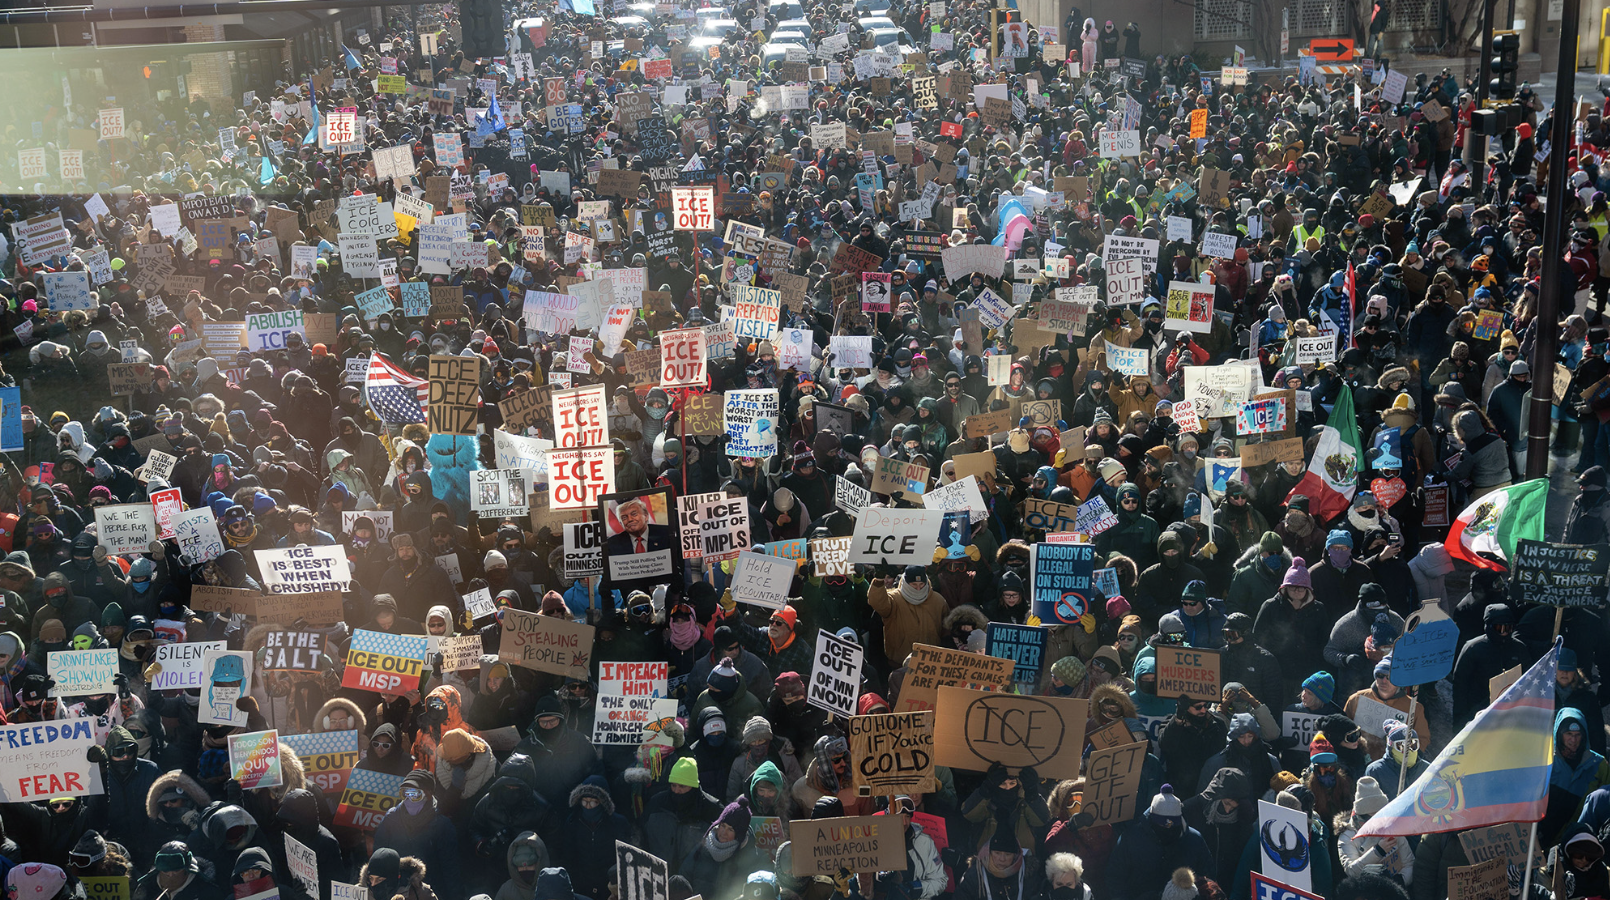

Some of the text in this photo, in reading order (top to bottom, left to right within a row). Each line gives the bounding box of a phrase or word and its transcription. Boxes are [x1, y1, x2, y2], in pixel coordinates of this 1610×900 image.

[915, 78, 936, 90] ICE
[952, 72, 968, 84] ICE
[433, 90, 450, 100] ICE
[914, 88, 937, 98] OUT
[950, 83, 970, 95] OUT
[428, 100, 452, 113] OUT
[621, 96, 639, 106] NO
[915, 96, 938, 108] NOW
[555, 106, 569, 117] BE
[621, 103, 650, 114] IMMUNITY
[102, 115, 121, 126] ICE
[629, 113, 646, 121] FOR
[329, 122, 350, 131] ICE
[638, 120, 665, 129] FUCK
[102, 126, 122, 137] OUT!
[329, 132, 352, 142] OUT!
[639, 130, 666, 139] THESE
[1102, 132, 1129, 140] MICRO
[641, 138, 668, 147] TEMU
[1103, 139, 1134, 152] PENIS
[22, 156, 42, 166] ICE
[62, 157, 80, 168] ICE
[22, 166, 44, 177] OUT!
[63, 167, 82, 178] OUT!
[649, 167, 679, 180] RIGHTS
[451, 176, 468, 187] SAY
[654, 181, 678, 192] LAWS
[396, 191, 426, 207] WHISTLE
[678, 198, 708, 212] ICE
[350, 204, 377, 218] ICE
[402, 206, 423, 220] WORK
[523, 206, 552, 217] DEPORT
[530, 216, 546, 226] ICE
[678, 215, 711, 229] OUT!
[201, 225, 226, 235] ICE
[526, 227, 539, 235] NO
[203, 237, 226, 248] OUT
[1207, 233, 1232, 242] ARREST
[524, 243, 543, 251] KING
[1209, 248, 1226, 256] ROSS
[526, 251, 542, 259] WAY
[1108, 260, 1136, 276] ICE
[866, 273, 888, 282] SASHAY
[1108, 276, 1141, 293] OUT
[402, 291, 430, 302] POWER
[434, 287, 457, 296] DONT
[737, 286, 781, 305] HISTORY
[1112, 291, 1144, 303] OF MN
[435, 296, 458, 304] LOOK
[736, 303, 780, 322] REPEATS
[867, 303, 886, 311] AWAY
[1042, 302, 1088, 315] NO HUMAN
[248, 311, 304, 331] ABOLISH
[1482, 317, 1501, 328] ICE
[735, 319, 776, 339] ITSELF
[1475, 326, 1498, 339] OUT
[258, 332, 291, 351] ICE
[662, 330, 701, 342] NEIGHBORS SAY
[663, 341, 700, 360] ICE
[785, 345, 798, 355] NO
[1299, 341, 1333, 352] ICE OUT
[1114, 357, 1134, 367] FOR
[664, 361, 703, 387] OUT!
[429, 382, 478, 406] DEEZ
[744, 394, 760, 402] ICE
[763, 394, 774, 402] IS
[559, 399, 589, 408] NEIGHBORS
[727, 401, 758, 409] AFTER
[1175, 401, 1192, 411] GOD
[727, 408, 755, 416] WORST
[429, 406, 477, 434] NUTZ
[552, 452, 592, 460] NEIGHBORS
[477, 468, 521, 482] SPOT THE
[553, 460, 605, 481] ICE
[554, 483, 609, 503] OUT!
[103, 511, 139, 521] WE THE
[477, 508, 524, 518] DIFFERENCE
[706, 503, 742, 519] ICE
[701, 517, 748, 531] OUT OF
[106, 534, 147, 546] THE MAN!
[706, 531, 748, 554] MPLS
[273, 558, 332, 571] IS BEST
[630, 562, 663, 570] Working-Class
[1038, 560, 1074, 575] ILLEGAL
[281, 570, 332, 582] WHEN
[1036, 574, 1089, 589] ON STOLEN
[1036, 589, 1062, 602] LAND
[1520, 584, 1592, 595] TO JUSTICE
[505, 613, 540, 633] STOP
[267, 631, 320, 648] BE THE
[514, 631, 578, 647] STEALING
[993, 628, 1042, 644] HATE WILL
[523, 645, 565, 664] PEOPLE
[824, 639, 853, 662] ICE
[264, 647, 322, 670] SALT
[348, 649, 422, 676] ICE OUT
[1174, 652, 1202, 667] ICE
[820, 655, 857, 678] OUT
[359, 670, 401, 690] MSP
[1160, 666, 1216, 682] MURDERS
[816, 670, 854, 696] OF MN
[1159, 678, 1217, 696] AMERICANS
[601, 697, 656, 710] THE ONLY
[812, 685, 854, 711] NOW
[608, 710, 648, 721] ORANGE
[597, 722, 643, 732] MONARCH
[233, 737, 275, 750] TODOS SON
[594, 732, 643, 743] I ADMIRE
[860, 750, 930, 778] COLD
[1090, 747, 1142, 781] GET
[19, 772, 85, 798] FEAR
[813, 840, 879, 858] MINNEAPOLIS
[817, 857, 879, 872] REACTION
